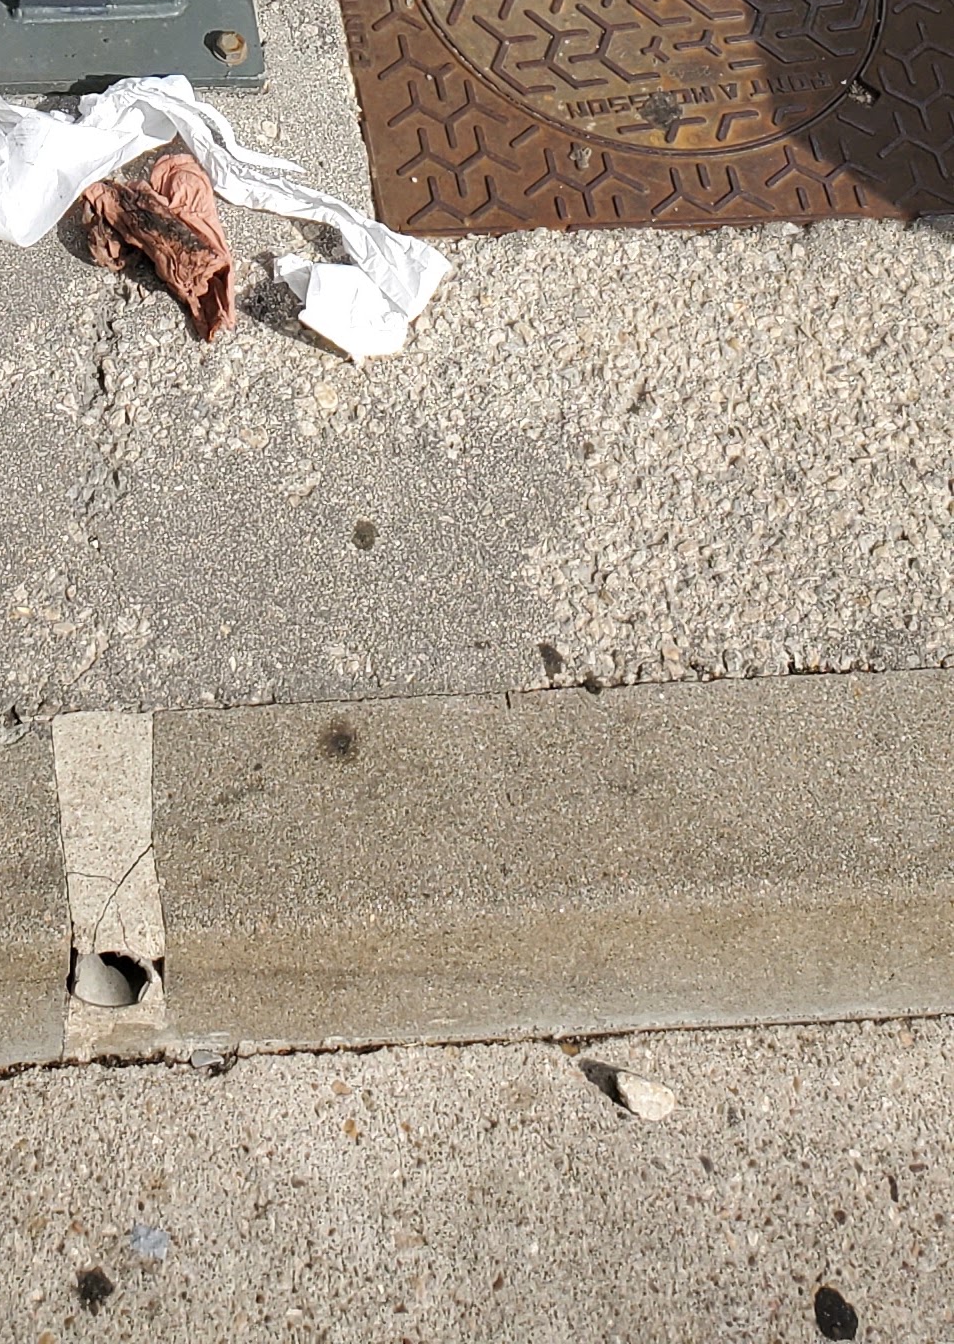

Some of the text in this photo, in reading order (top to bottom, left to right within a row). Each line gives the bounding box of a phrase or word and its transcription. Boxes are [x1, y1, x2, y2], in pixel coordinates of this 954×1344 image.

[718, 82, 738, 100] A
[748, 70, 833, 99] PONT
[565, 86, 715, 119] MOSSON
